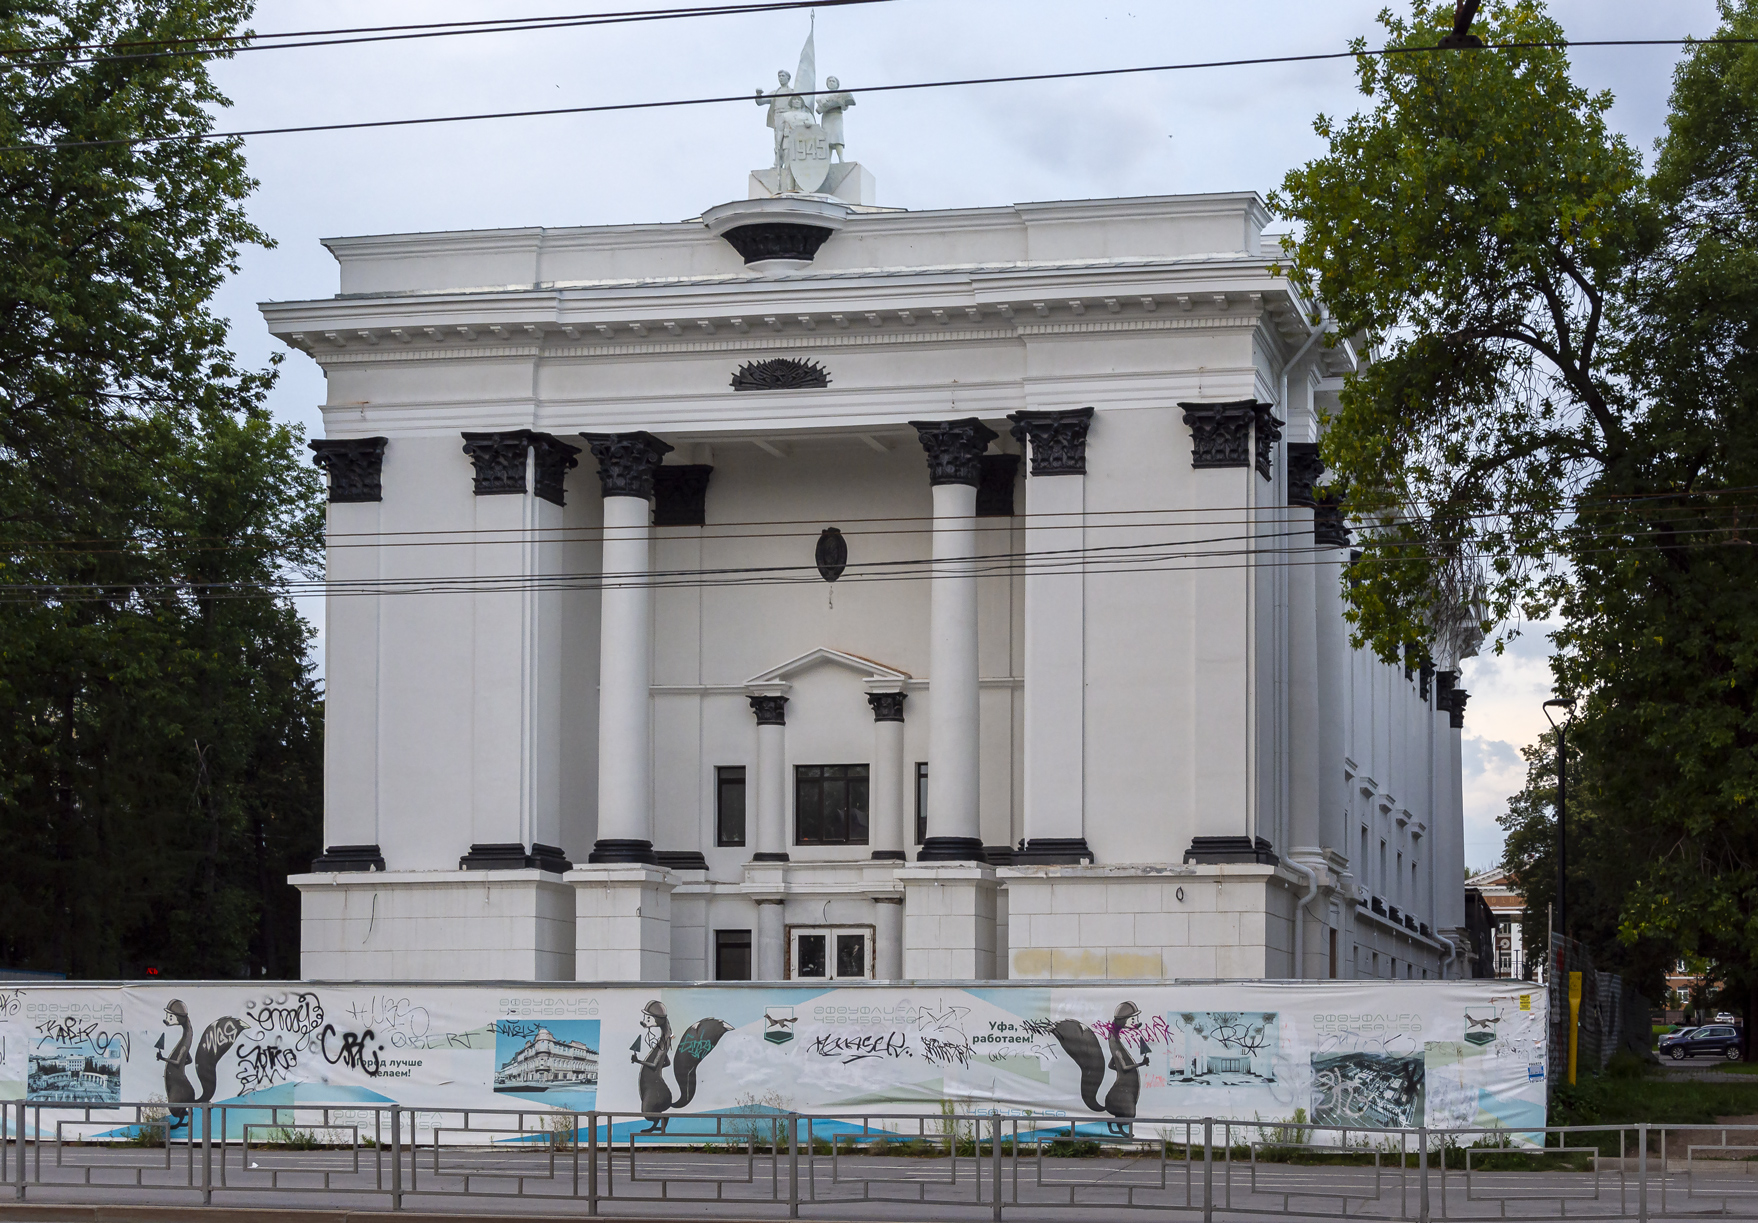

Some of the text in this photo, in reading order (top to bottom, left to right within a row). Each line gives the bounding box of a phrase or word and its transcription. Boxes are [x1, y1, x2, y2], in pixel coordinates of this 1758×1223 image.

[791, 137, 827, 161] 1945
[988, 1021, 1018, 1033] Уфа,
[972, 1033, 1034, 1045] работаем!
[389, 1059, 423, 1068] лучше
[369, 1068, 411, 1078] елаем!
